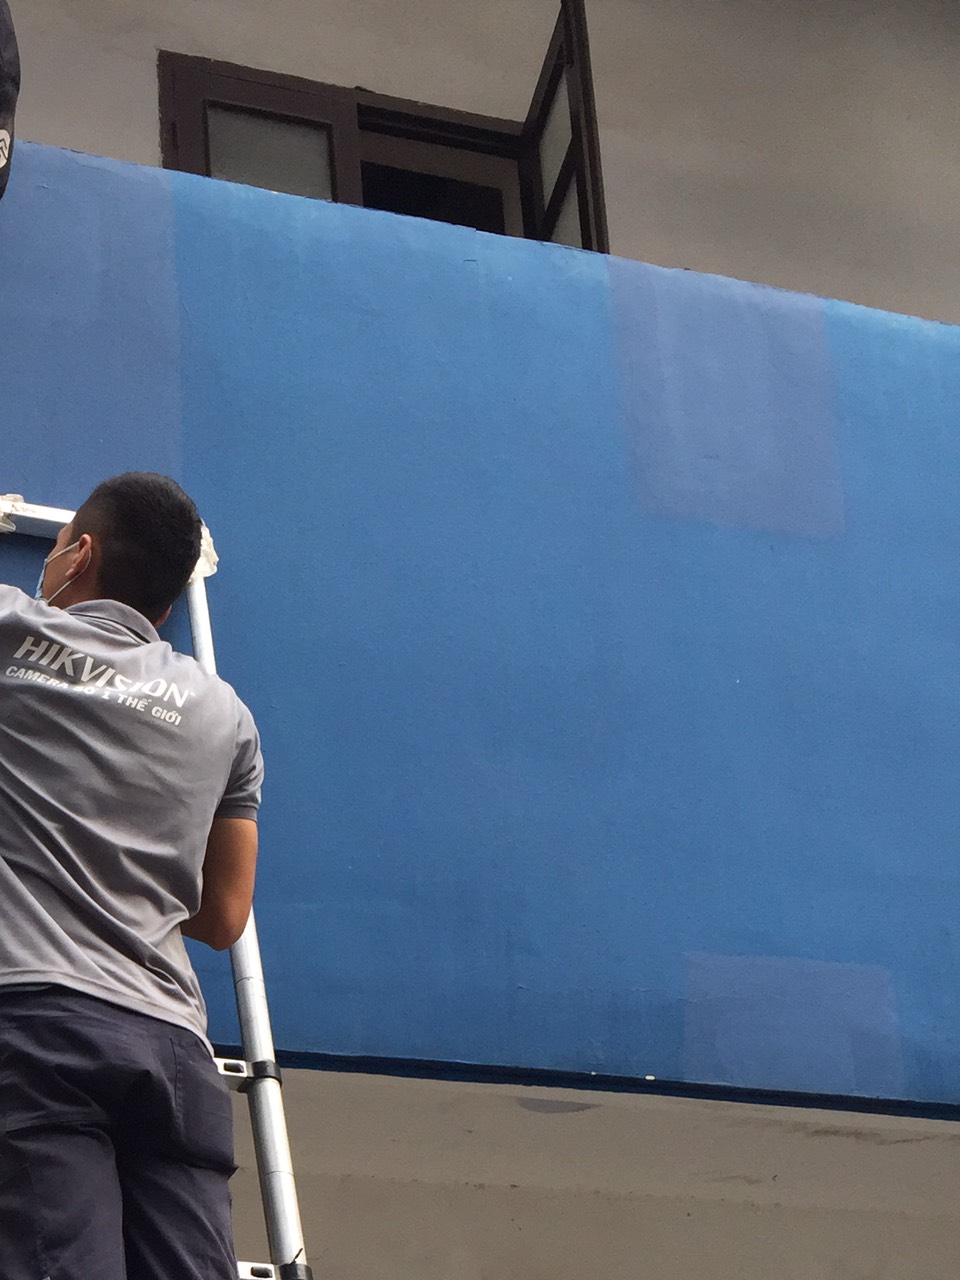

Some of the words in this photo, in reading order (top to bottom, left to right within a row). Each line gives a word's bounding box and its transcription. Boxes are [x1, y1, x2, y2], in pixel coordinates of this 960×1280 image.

[5, 666, 68, 689] CAMERA
[152, 706, 182, 726] GIỚI
[13, 636, 189, 708] HIKVISION
